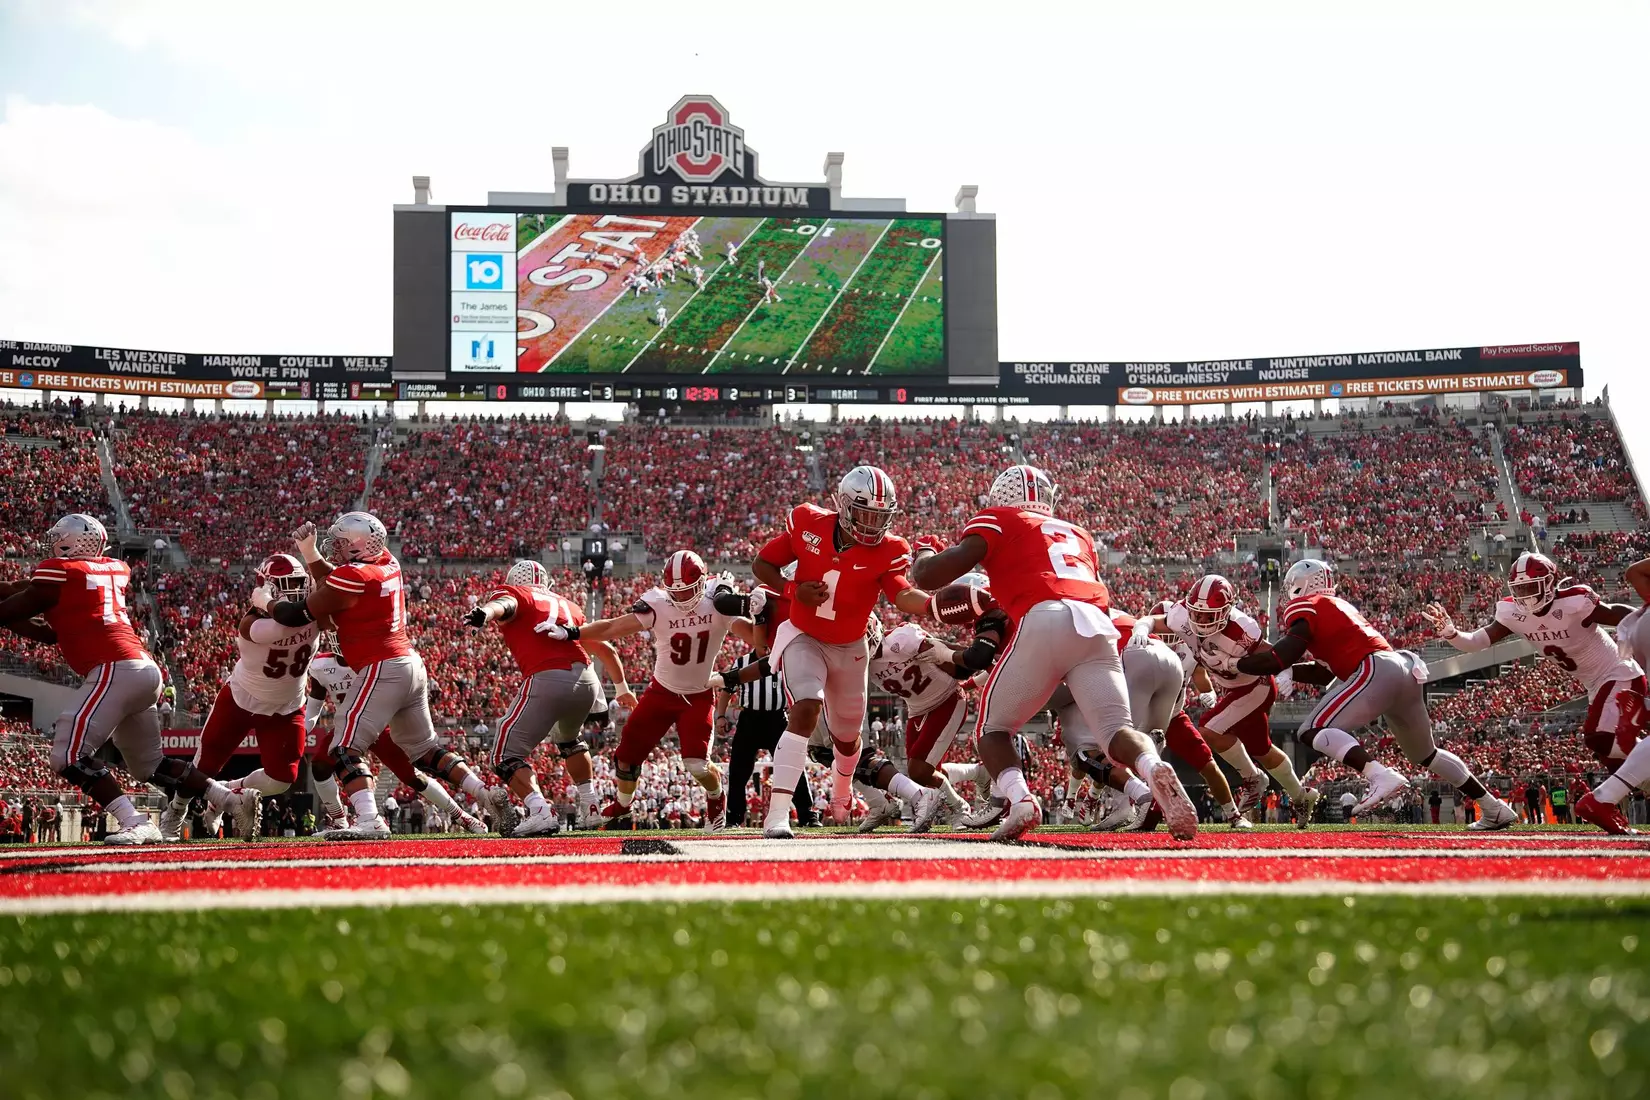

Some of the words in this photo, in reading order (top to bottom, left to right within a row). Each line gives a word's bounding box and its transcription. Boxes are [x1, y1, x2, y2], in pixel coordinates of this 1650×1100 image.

[656, 125, 692, 171] OHIO
[693, 120, 742, 172] STATE
[589, 184, 661, 205] OHIO
[672, 185, 809, 207] STADIUM
[469, 260, 500, 284] 10
[461, 302, 477, 310] The
[480, 302, 508, 310] James
[23, 342, 72, 353] DIAMOND
[1483, 347, 1497, 356] Pay
[1499, 345, 1531, 354] Forward
[1533, 344, 1563, 353] Society
[12, 354, 60, 368] McCOY
[95, 349, 120, 361] LES
[124, 351, 186, 365] WEXNER
[203, 356, 261, 367] HARMON
[279, 357, 333, 368] COVELLI
[343, 357, 388, 368] WELLS
[1270, 355, 1352, 369] HUNTINGTON
[1357, 352, 1422, 365] NATIONAL
[1425, 350, 1462, 361] BANK
[108, 361, 176, 375] WANDELL
[231, 367, 277, 377] WOLFE
[282, 368, 309, 378] FDN
[1014, 364, 1054, 374] BLOCH
[1070, 364, 1110, 374] CRANE
[1125, 363, 1171, 374] PHIPPS
[1187, 360, 1253, 373] McCORKLE
[1025, 374, 1101, 384] SCHUMAKER
[1128, 372, 1230, 384] O'SHAUGHNESSY
[1258, 368, 1309, 381] NOURSE
[37, 374, 68, 386] FREE
[71, 376, 121, 390] TICKETS
[123, 379, 157, 392] WITH
[160, 381, 222, 395] ESTIMATE!
[1347, 382, 1374, 393] FREE
[1381, 379, 1424, 392] TICKETS
[1427, 378, 1459, 389] WITH
[1462, 375, 1525, 388] ESTIMATE!
[523, 387, 545, 397] OHIO
[549, 387, 577, 398] STATE
[604, 387, 612, 399] 3
[666, 388, 678, 400] 10
[686, 387, 719, 401] 12:34
[831, 390, 858, 400] MIAMI
[1155, 390, 1182, 401] FREE
[1184, 388, 1230, 400] TICKETS
[1231, 387, 1262, 398] WITH
[1265, 384, 1325, 397] ESTIMATE!
[1040, 519, 1097, 582] 2
[815, 569, 841, 621] 1
[669, 613, 713, 629] MIAMI
[273, 627, 313, 648] MIAMI
[1523, 630, 1570, 642] MIAMI
[670, 630, 710, 666] 91
[262, 643, 313, 679] 58
[1543, 645, 1577, 672] 3
